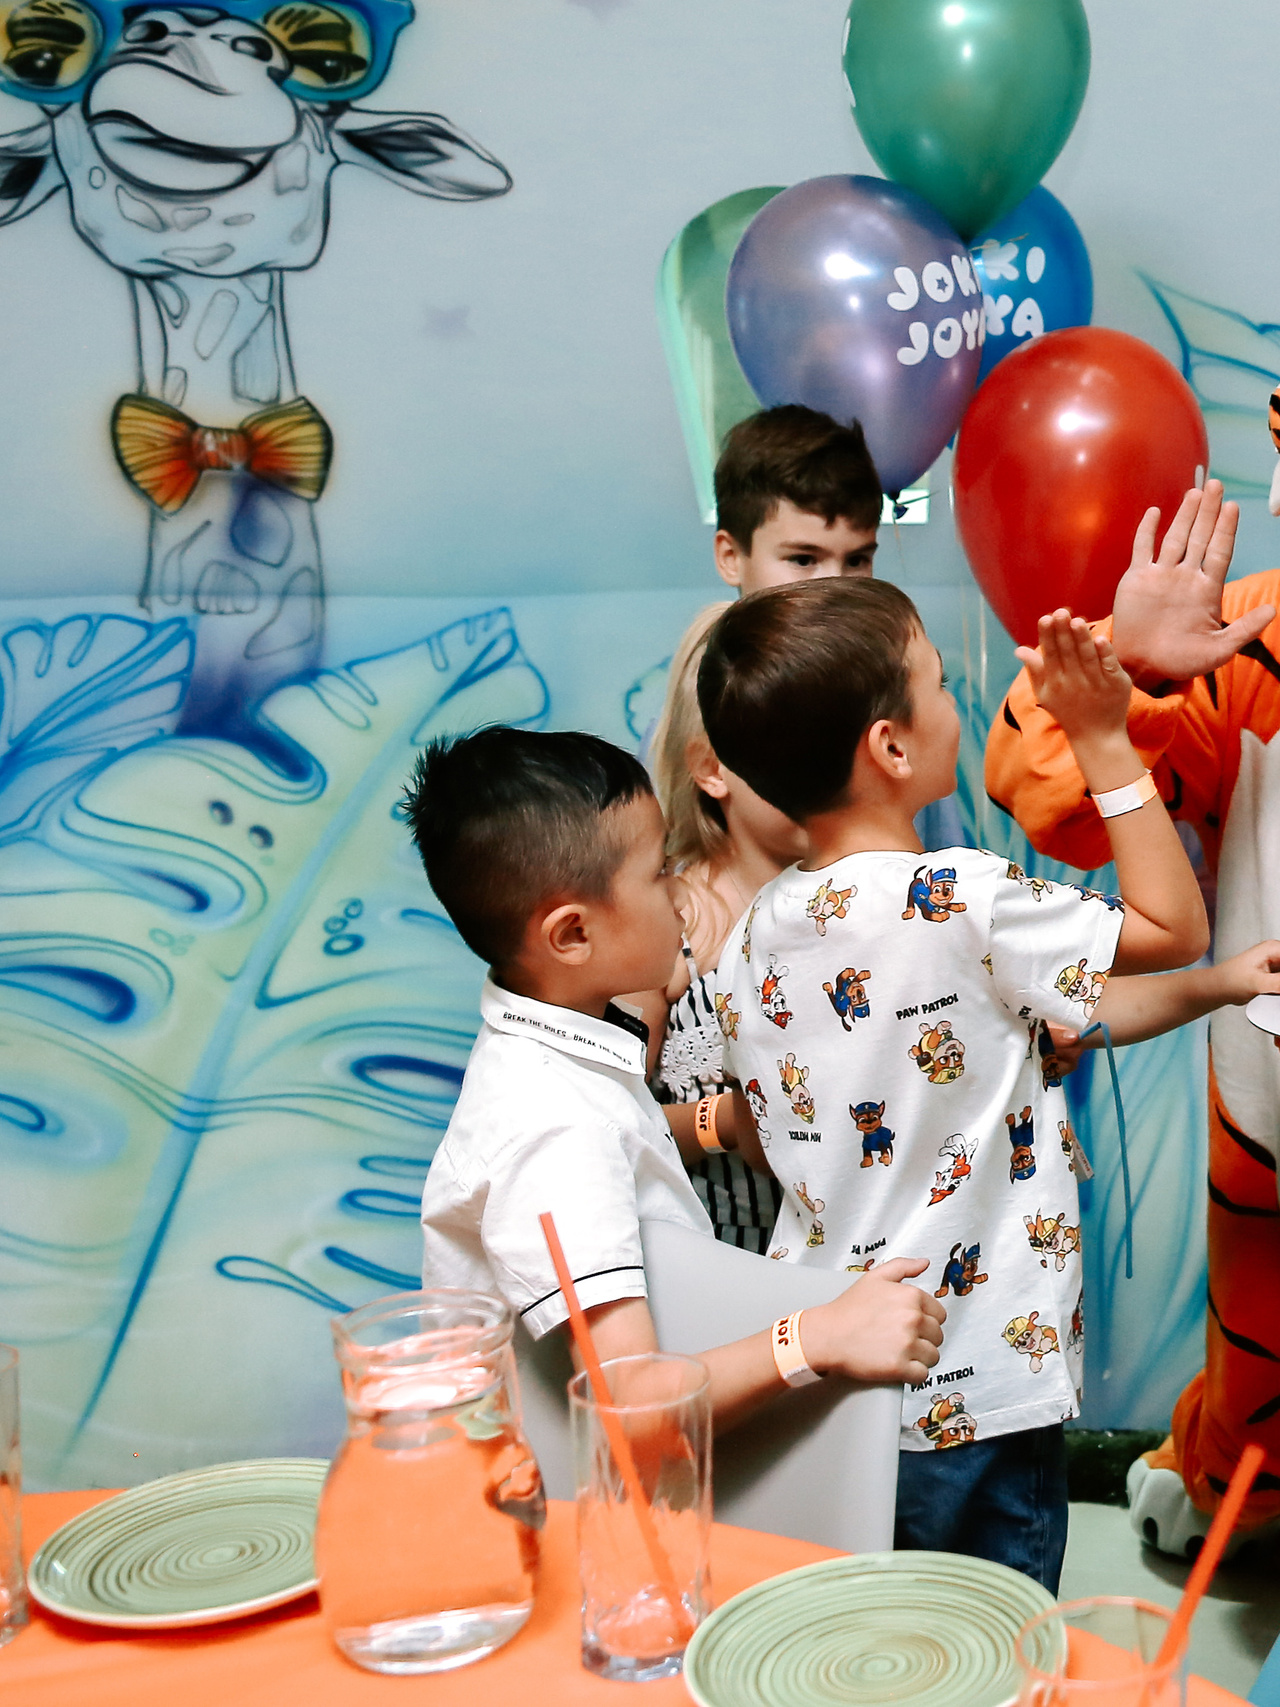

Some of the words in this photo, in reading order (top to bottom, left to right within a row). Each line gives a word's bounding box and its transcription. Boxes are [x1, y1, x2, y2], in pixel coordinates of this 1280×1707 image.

[981, 239, 1045, 284] KI
[983, 294, 1044, 338] YA
[503, 1011, 527, 1023] BREAK
[529, 1019, 542, 1027] THE
[896, 1005, 919, 1020] PAW
[921, 993, 959, 1014] PATROL
[699, 1101, 709, 1131] JOKI
[778, 1317, 789, 1346] JOK
[936, 1366, 974, 1385] PATROL
